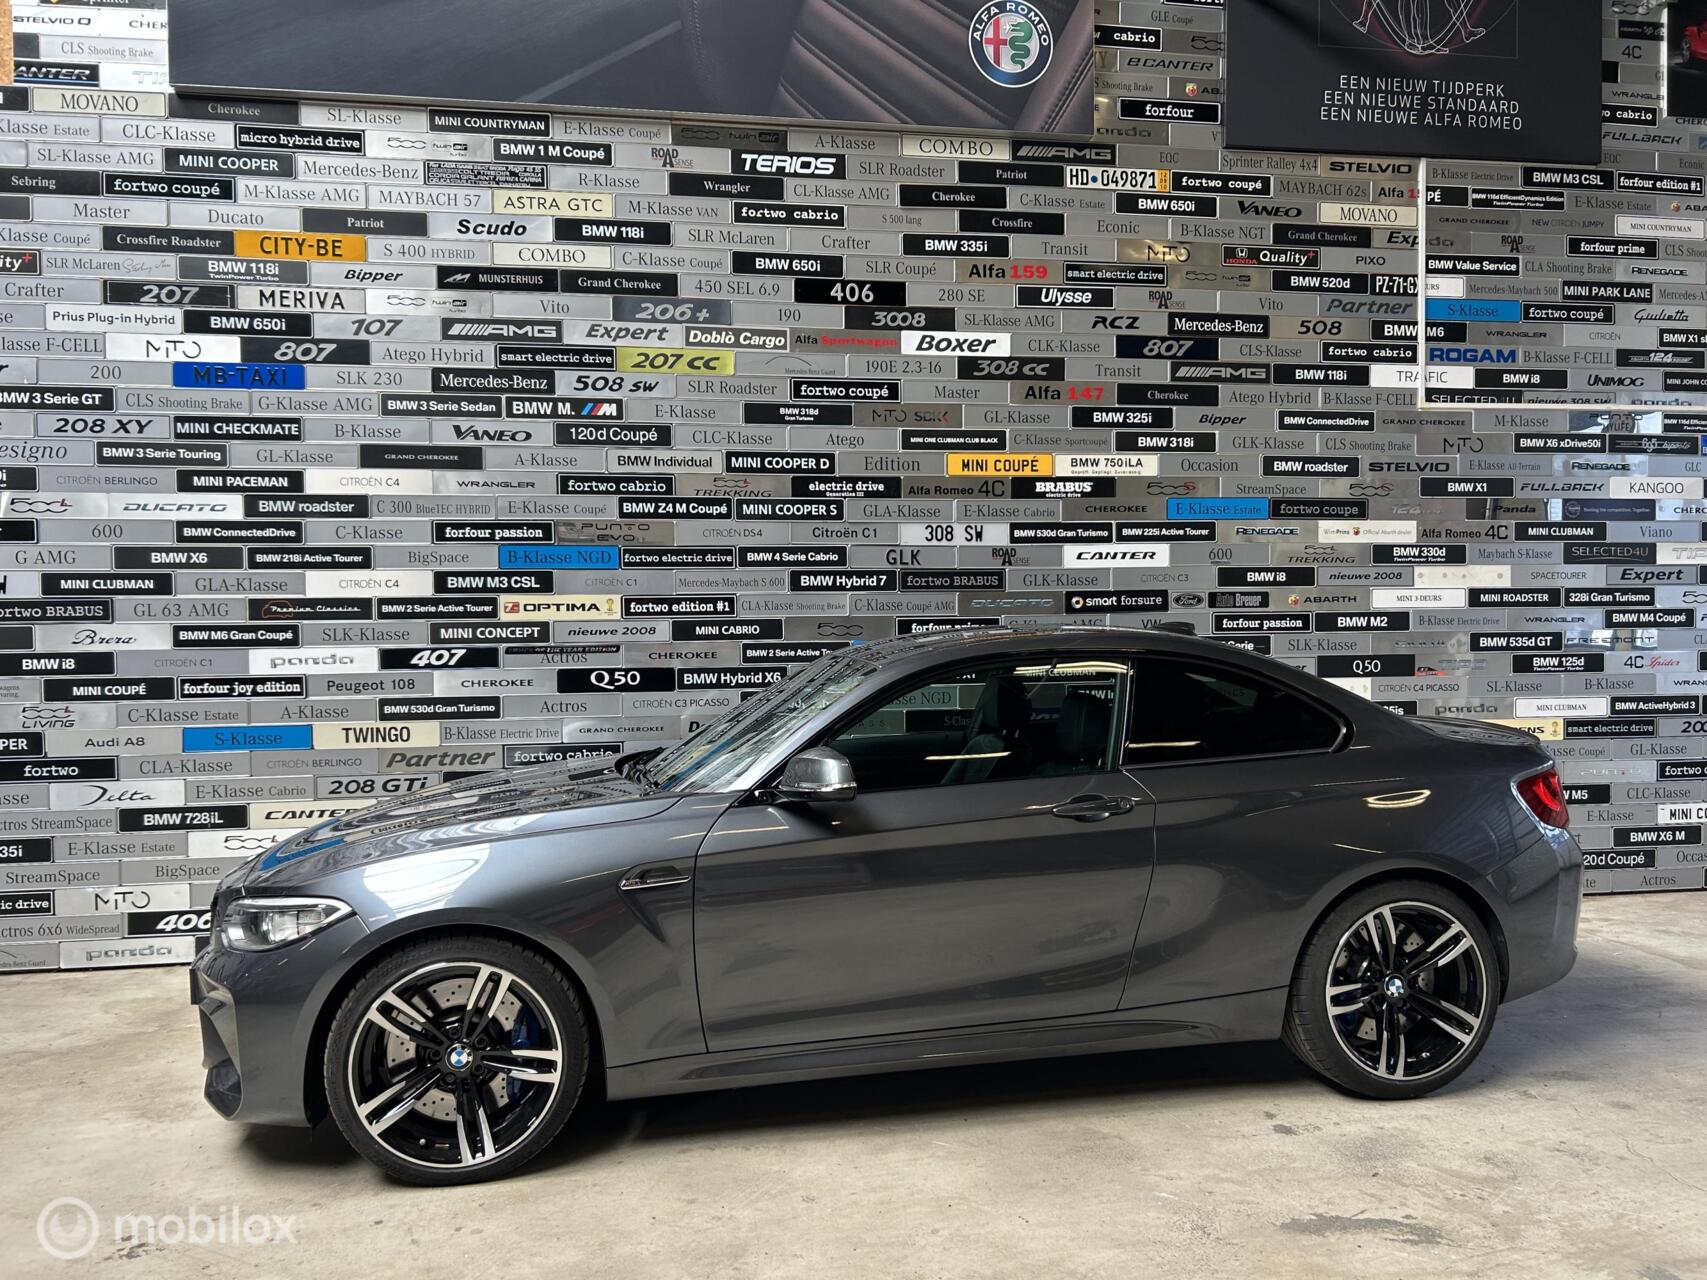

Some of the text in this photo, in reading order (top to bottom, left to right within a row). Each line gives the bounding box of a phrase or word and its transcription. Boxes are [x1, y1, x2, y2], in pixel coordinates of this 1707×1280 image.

[974, 3, 1049, 46] ALFA ROMEO
[1114, 31, 1155, 43] cabrio
[61, 42, 153, 58] CLS Shooting Brake
[1341, 76, 1504, 97] EEN NIEUW TIJDPERK
[61, 94, 138, 112] MOVANO
[1325, 91, 1519, 114] EEN NIEUWE STANDAARD
[328, 108, 401, 125] SL-Klasse
[1145, 105, 1194, 118] forfour
[1321, 107, 1522, 130] EEN NIEUWE ALFA ROMEO
[435, 117, 545, 131] MINI COUNTRYMAN
[241, 133, 360, 148] micro hybrid drive
[919, 139, 993, 156] COMBO
[179, 155, 278, 171] MINI COOPER
[303, 161, 419, 179] Mercedes-Benz
[741, 154, 836, 175] TERIOS
[1330, 161, 1412, 174] STELVIO
[996, 169, 1027, 180] Patriot
[1533, 173, 1603, 185] BMW M3 CSL
[11, 176, 56, 188] Sebring
[114, 179, 220, 198] fortwo coupé
[704, 182, 751, 193] Wrangler
[1620, 177, 1700, 191] forfour edition #1
[504, 196, 602, 212] ASTRA GTC
[208, 209, 263, 225] Ducato
[1341, 208, 1397, 222] MOVANO
[457, 219, 527, 236] Scudo
[1097, 220, 1139, 234] Econic
[117, 234, 221, 248] Crossfire Roadster
[261, 236, 343, 257] CITY-BE
[1042, 242, 1088, 256] Transit
[1356, 256, 1385, 266] PIXO
[1429, 260, 1516, 271] BMW Value Service
[479, 273, 543, 284] MUNSTERHUIS
[969, 264, 1048, 279] Alfa 159
[5, 282, 64, 298] Crafter
[578, 277, 661, 290] Grand Cherokee
[695, 280, 780, 297] 450 SEL 6.9
[142, 286, 199, 302] 207
[830, 283, 874, 301] 406
[1041, 289, 1091, 304] Ulysse
[1564, 286, 1650, 298] MINI PARK LANE
[260, 290, 344, 309] MERIVA
[540, 300, 569, 313] Vito
[1448, 305, 1498, 317] S-Klasse
[53, 312, 175, 327] Prius Plug-in Hybrid
[211, 317, 286, 330] BMW 650i
[872, 312, 926, 327] 3008
[1092, 316, 1139, 329] RCZ
[351, 319, 402, 336] 107
[586, 324, 669, 341] Expert
[1298, 321, 1342, 335] 508
[689, 330, 785, 348] Doblò Cargo
[916, 335, 996, 353] Boxer
[1028, 339, 1100, 353] CLK-Klasse
[1143, 341, 1193, 356] 807
[1429, 348, 1516, 362] ROGAM
[195, 366, 286, 386] MB-TAXI
[53, 419, 153, 433] 208 XY
[177, 422, 299, 435] MINI CHECKMATE
[1494, 416, 1548, 427] M-Klasse
[618, 456, 712, 468] BMW Individual
[864, 457, 920, 471] Edition
[962, 456, 1039, 473] MINI COUPÉ
[457, 480, 535, 489] WRANGLER
[1036, 481, 1091, 492] BRABUS
[1630, 483, 1684, 494] KANGOO
[1176, 503, 1261, 514] E-Klasse Estate
[92, 525, 123, 538] 600
[445, 527, 542, 540] forfour passion
[812, 527, 878, 538] Citroën C1
[925, 525, 982, 541] 308 SW
[1640, 527, 1672, 537] Viano
[508, 550, 611, 564] B-Klasse NGD
[886, 549, 920, 565] GLK
[1076, 551, 1156, 560] CANTER
[1086, 594, 1162, 607] smart forsure
[1569, 593, 1650, 602] 328i Gran Turismo
[523, 603, 600, 612] OPTIMA
[72, 630, 137, 646] Brera
[441, 627, 540, 638] MINI CONCEPT
[1480, 637, 1552, 646] BMW 535d GT
[411, 650, 466, 666] 407
[649, 651, 717, 660] CHEROKEE
[328, 679, 415, 693] Peugeot 108
[590, 670, 640, 688] Q50
[1615, 701, 1695, 711] BMW ActiveHybrid 3
[85, 737, 145, 747] Audi A8
[215, 732, 281, 745] S-Klasse
[342, 727, 410, 744] TWINGO
[387, 751, 495, 768] Partner
[24, 764, 78, 776] fortwo
[1627, 788, 1691, 799] CLC-Klasse
[144, 812, 223, 824] BMW 728iL
[1630, 831, 1685, 842] BMW X6 M
[6, 869, 100, 884] StreamSpace
[156, 864, 220, 879] BigSpace
[1641, 875, 1676, 887] Actros
[86, 945, 172, 960] panda
